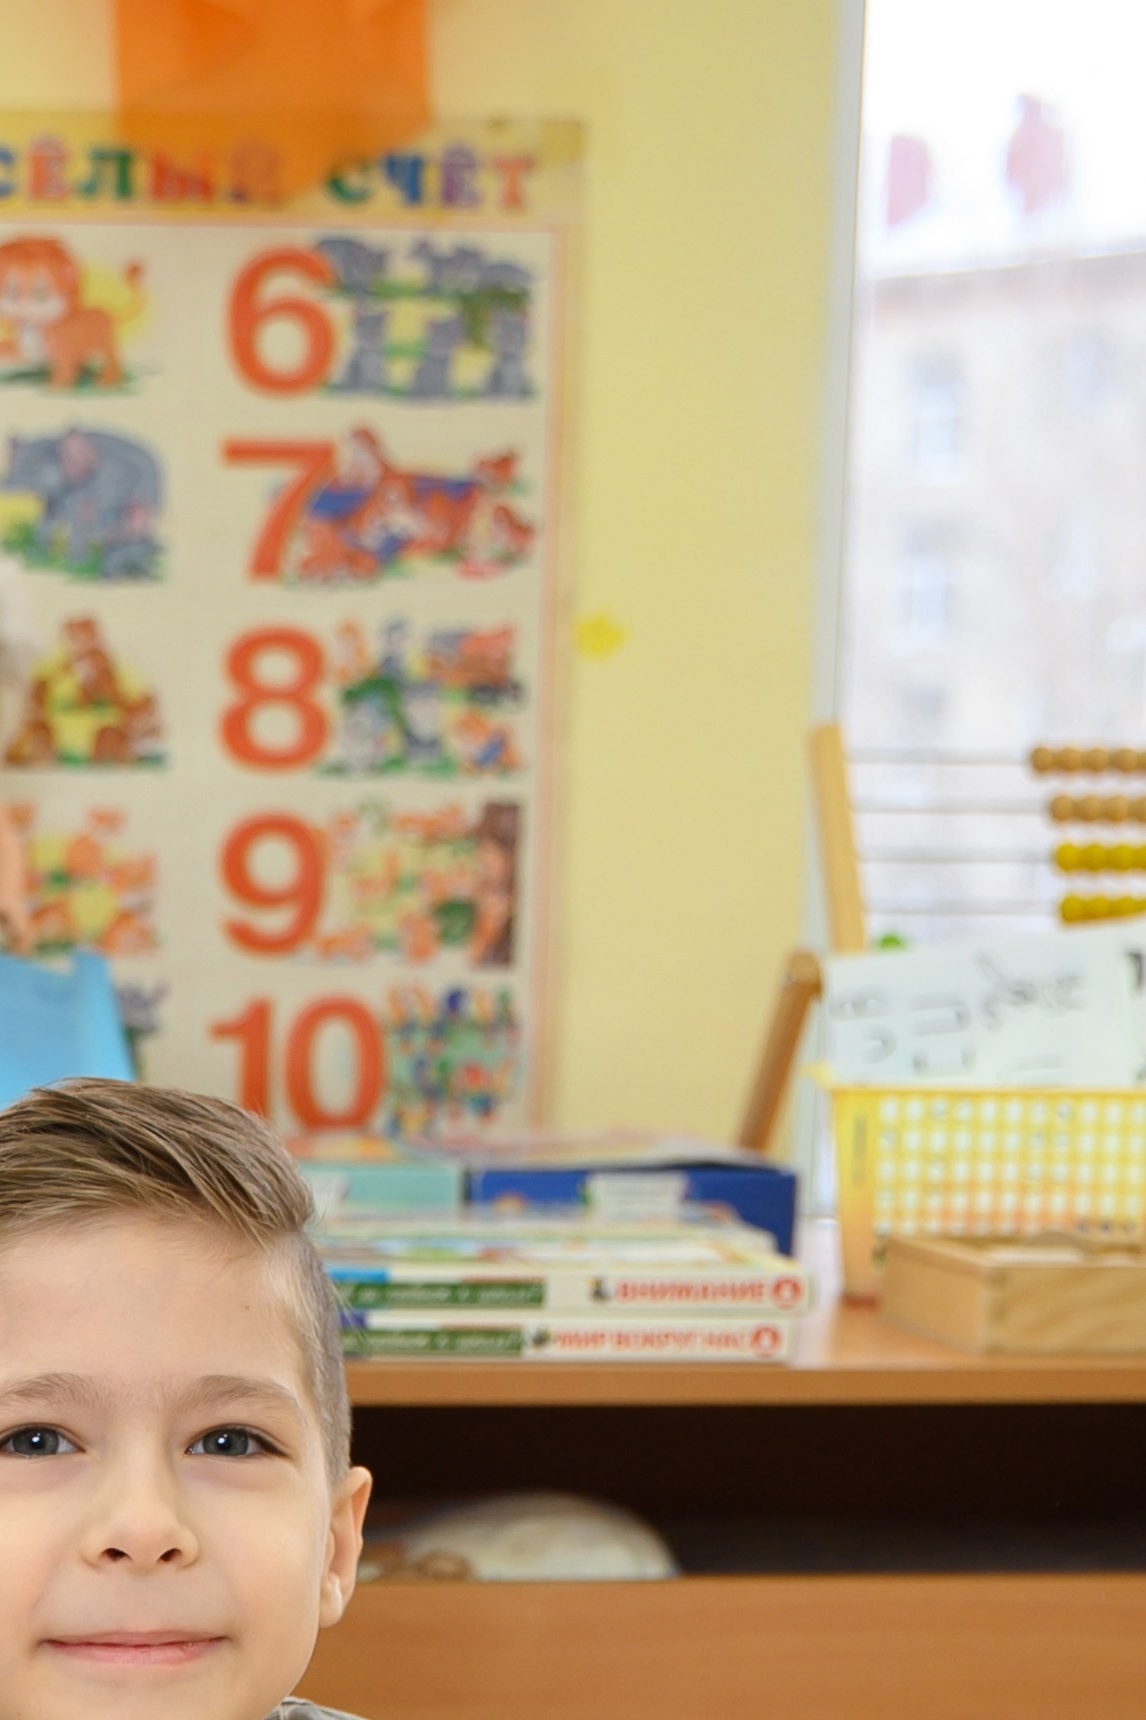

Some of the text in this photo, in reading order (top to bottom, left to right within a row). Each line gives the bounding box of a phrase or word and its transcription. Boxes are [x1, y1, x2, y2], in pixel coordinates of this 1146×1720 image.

[326, 141, 535, 207] СЧЁТ
[226, 245, 336, 395] 6
[222, 438, 337, 582] 7
[219, 625, 330, 771] 8
[220, 813, 326, 955] 9
[208, 995, 387, 1132] 10
